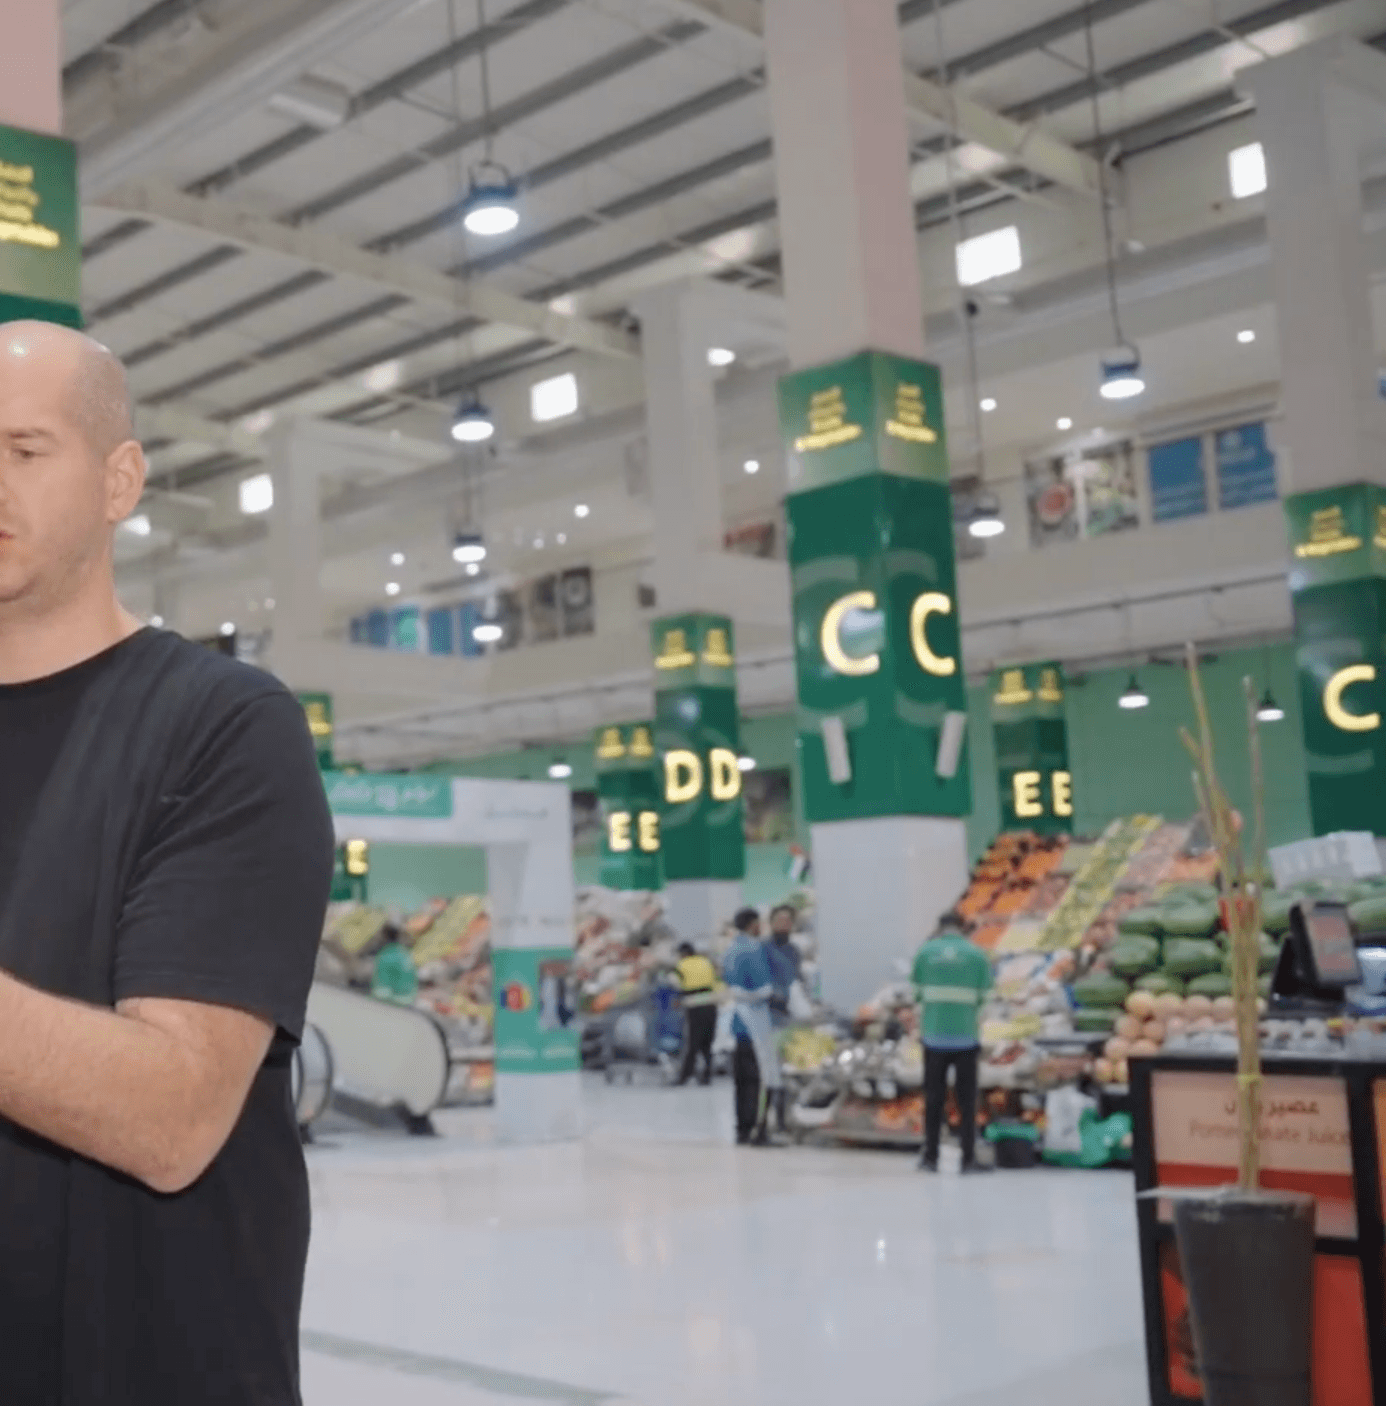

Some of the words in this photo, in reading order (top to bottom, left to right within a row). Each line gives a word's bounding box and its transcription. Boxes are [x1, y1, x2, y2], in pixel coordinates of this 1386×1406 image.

[821, 592, 880, 675] C
[911, 592, 956, 675] C
[1324, 664, 1381, 731] C
[665, 749, 703, 803] D
[710, 747, 741, 800] D
[1014, 770, 1043, 817] E
[1052, 770, 1073, 816] E
[608, 811, 631, 852] E
[638, 811, 660, 852] E
